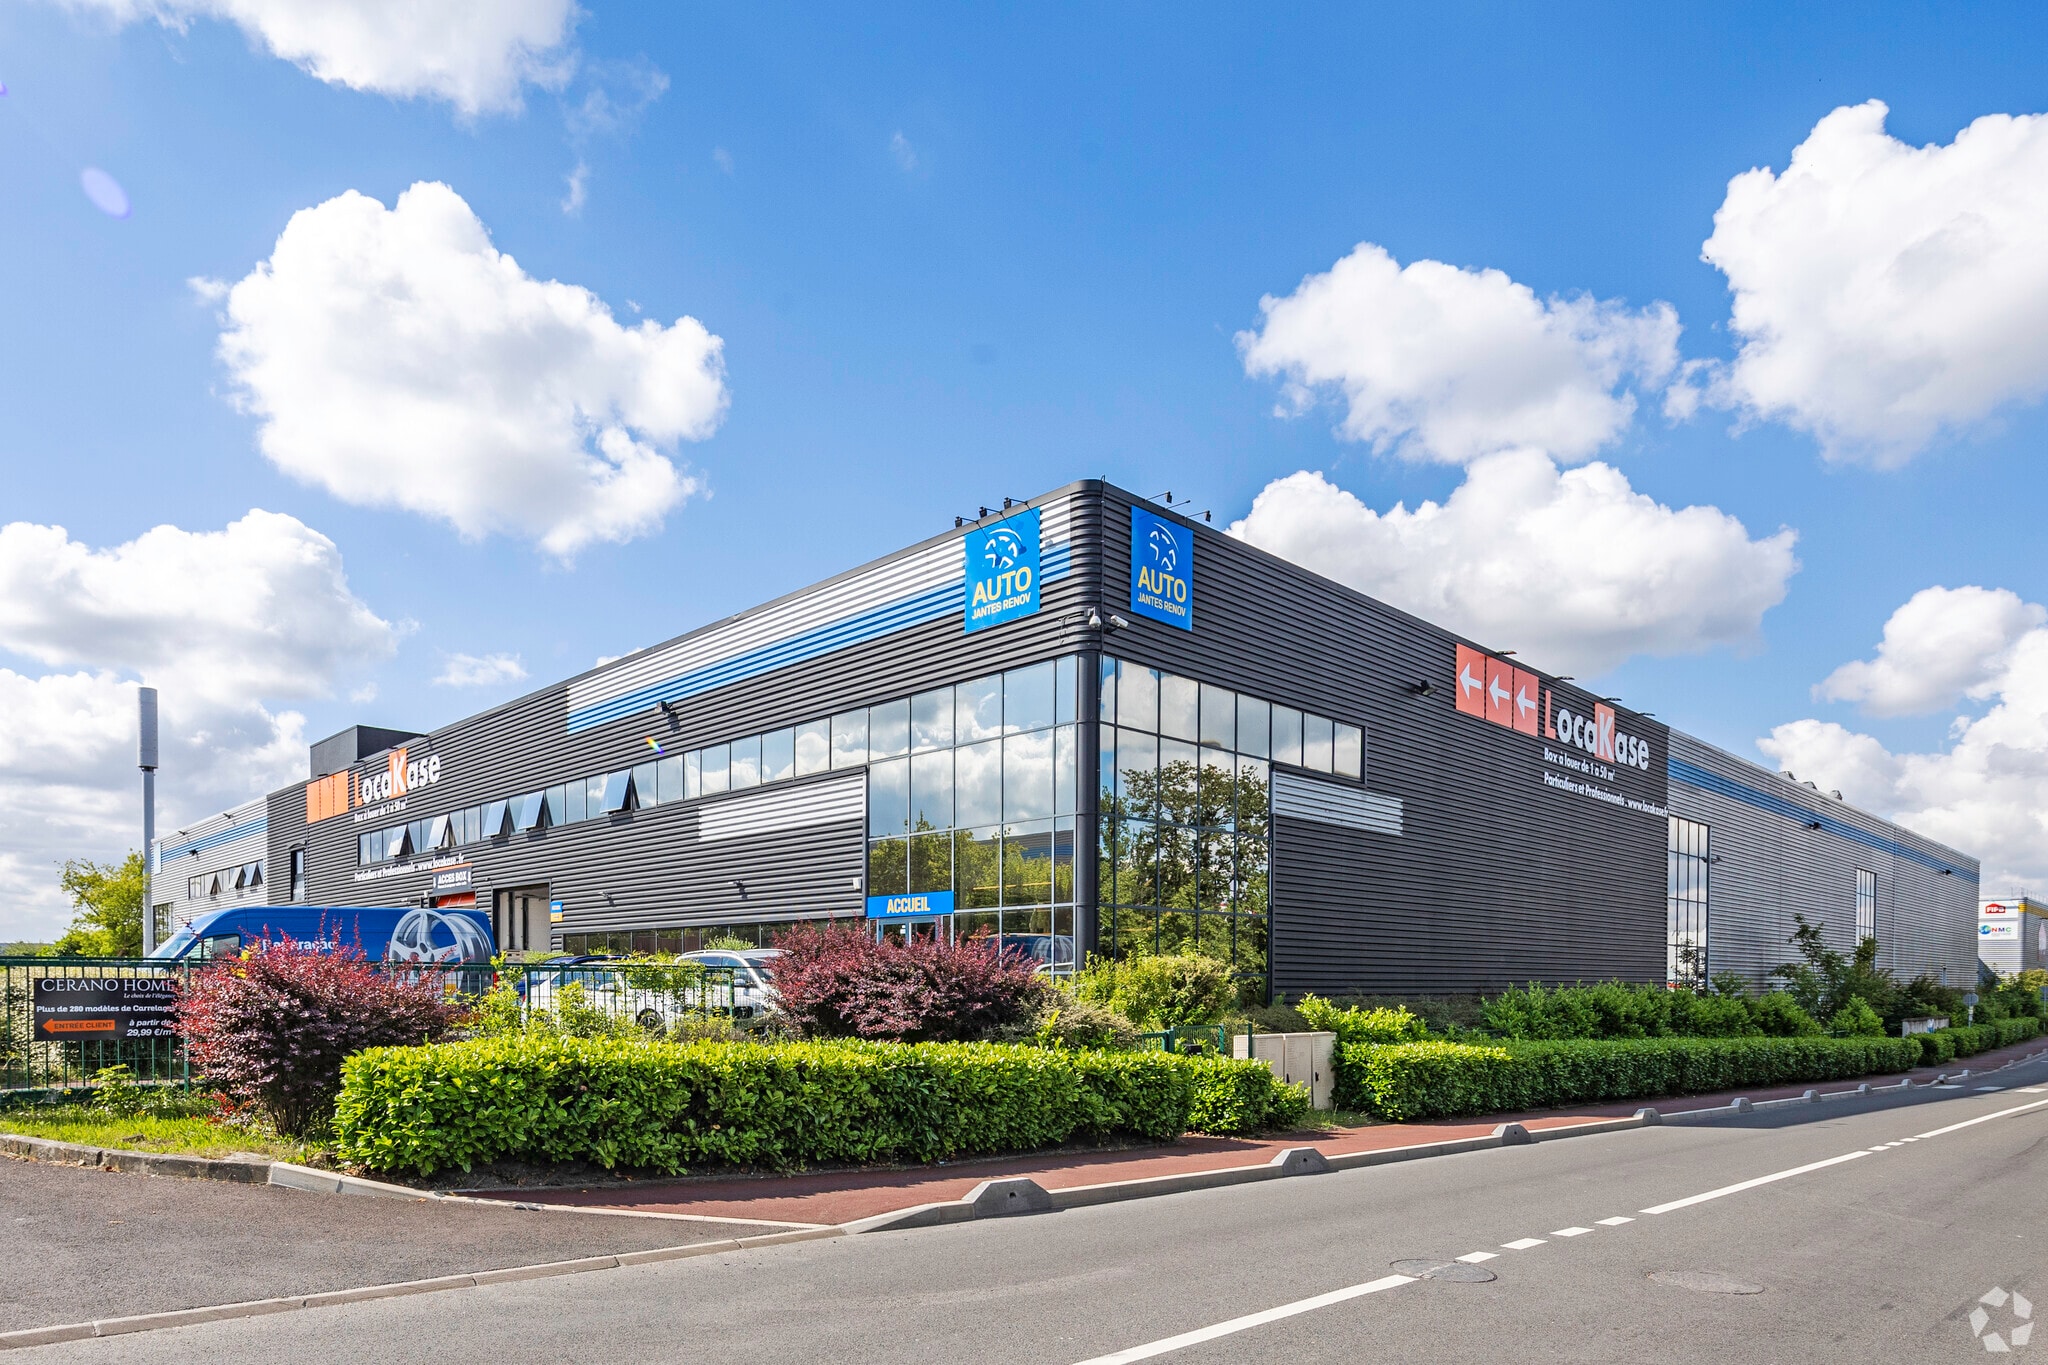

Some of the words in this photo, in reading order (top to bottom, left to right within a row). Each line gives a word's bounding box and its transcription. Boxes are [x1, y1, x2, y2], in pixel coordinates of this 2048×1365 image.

[971, 566, 1032, 607] AUTO
[1137, 565, 1187, 603] AUTO
[971, 601, 1002, 620] JANTES
[1002, 592, 1031, 611] RENOV
[1137, 592, 1163, 610] JANTES
[1163, 600, 1186, 617] RENOV
[1544, 689, 1649, 770] LocaKase
[1544, 747, 1558, 763] Box
[1559, 751, 1564, 765] à
[1564, 753, 1581, 770] louer
[1581, 759, 1589, 773] de
[1590, 762, 1594, 775] 1
[1600, 765, 1607, 779] 50
[354, 755, 440, 807] LocaKase
[1544, 771, 1578, 792] Particuliers
[1578, 784, 1585, 795] et
[1585, 784, 1625, 806] Professionnels
[455, 870, 468, 882] BOX
[886, 896, 931, 914] ACCUEIL
[41, 979, 119, 992] CERANO
[123, 979, 176, 992] HOME
[36, 1005, 56, 1013] Plus
[84, 1004, 120, 1012] modèles
[126, 1029, 152, 1037] 29,99
[136, 1019, 160, 1027] partir
